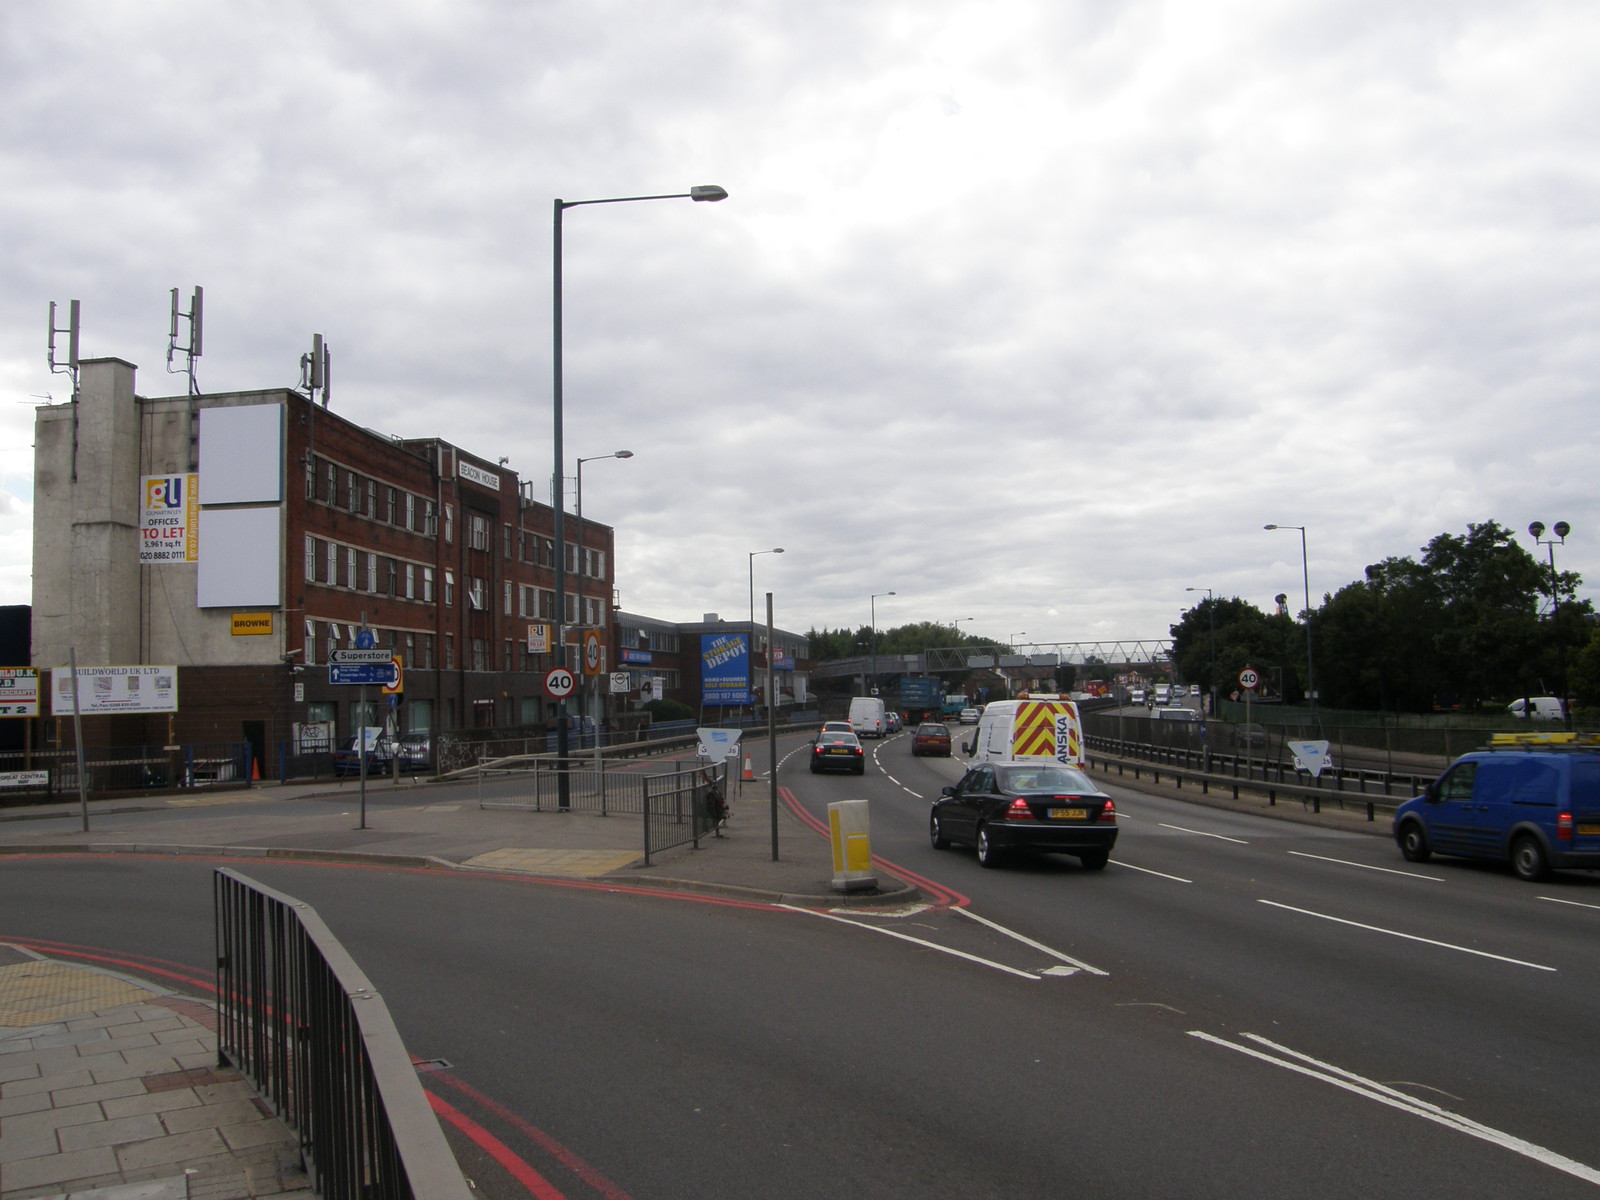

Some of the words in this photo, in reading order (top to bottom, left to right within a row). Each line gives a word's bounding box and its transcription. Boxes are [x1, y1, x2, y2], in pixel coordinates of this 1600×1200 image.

[461, 464, 481, 481] BEACON
[482, 473, 498, 488] HOUSE
[148, 518, 179, 526] OFFICES
[141, 528, 159, 539] TO
[163, 527, 185, 538] LET
[141, 552, 153, 560] 020
[172, 551, 185, 559] 0111
[234, 620, 270, 628] BROWNE
[711, 635, 727, 648] THE
[588, 644, 597, 660] 40
[703, 636, 743, 660] STORAGE
[341, 651, 390, 660] Superstore
[706, 642, 746, 669] DEPOT
[143, 667, 160, 675] LTD
[549, 676, 571, 688] 40
[1241, 674, 1256, 683] 40
[16, 706, 27, 714] 2
